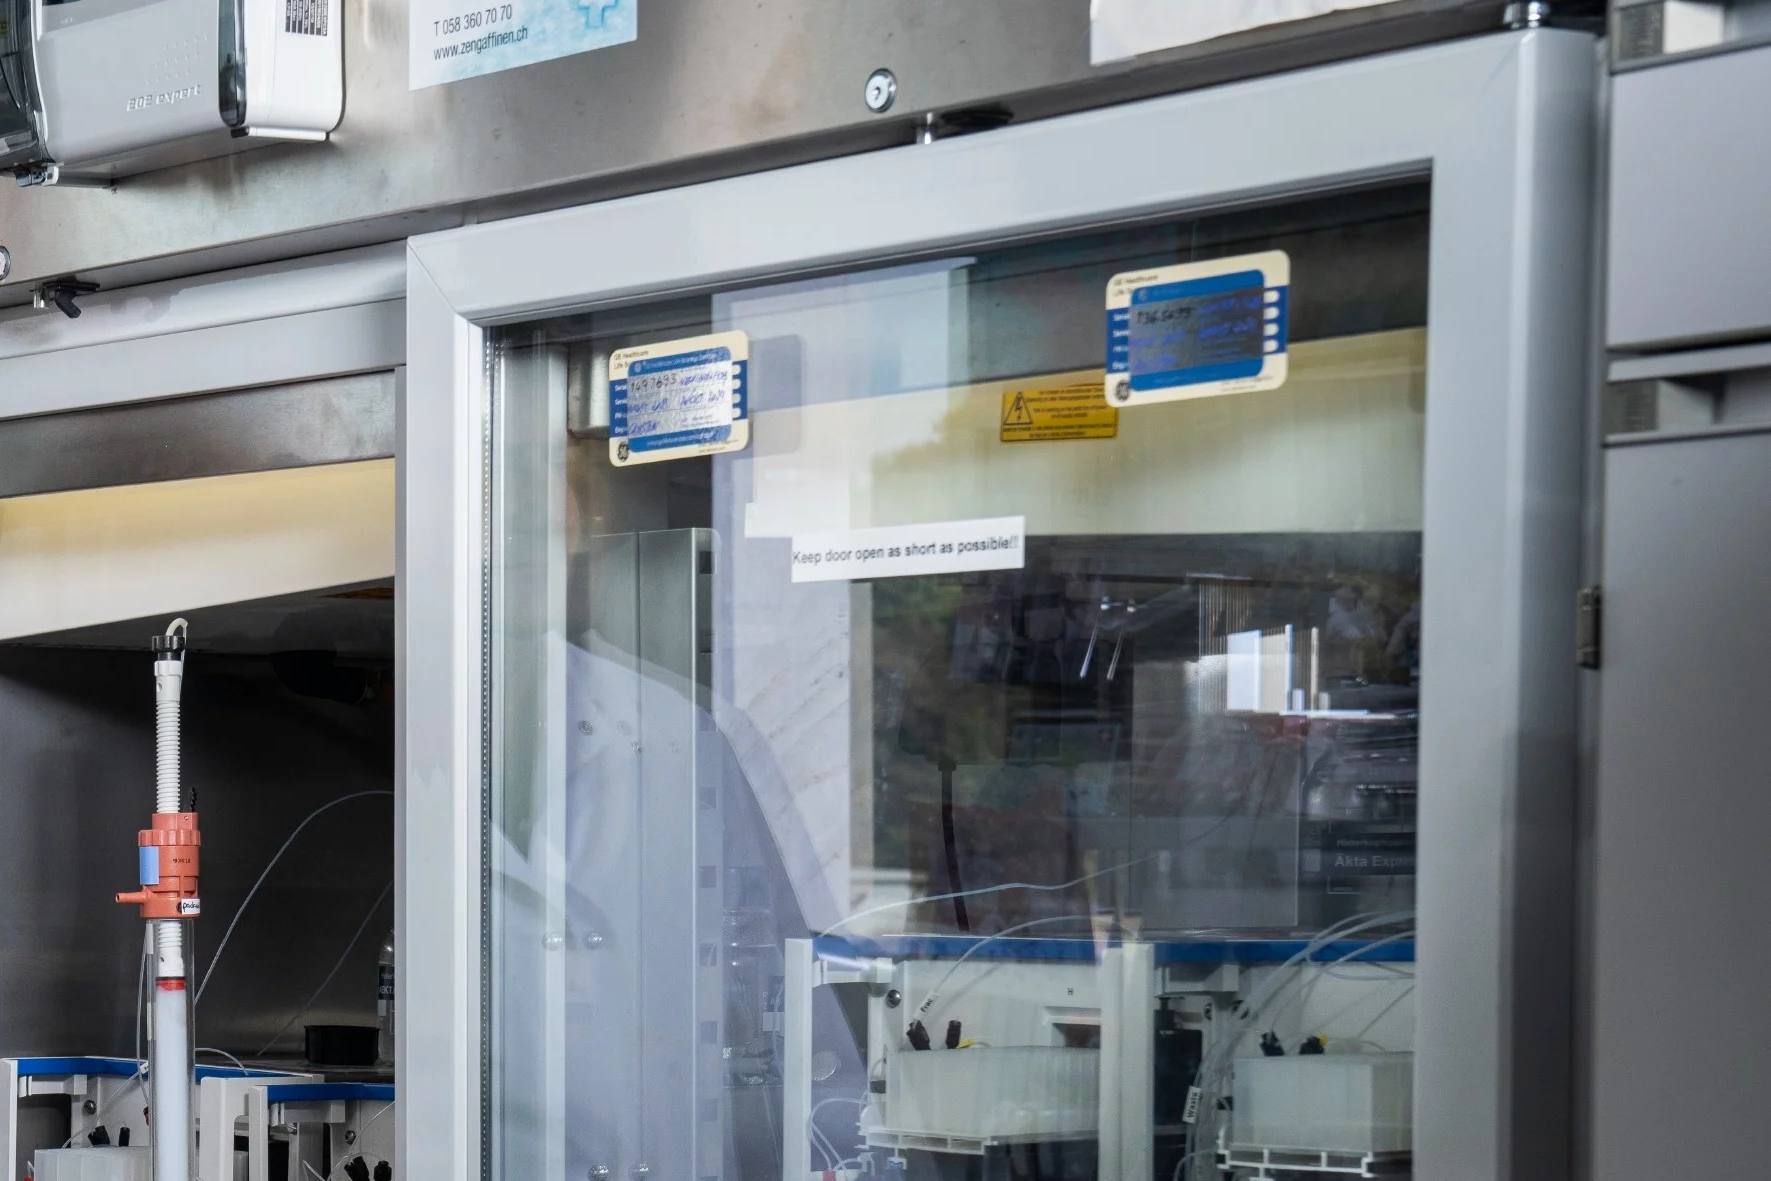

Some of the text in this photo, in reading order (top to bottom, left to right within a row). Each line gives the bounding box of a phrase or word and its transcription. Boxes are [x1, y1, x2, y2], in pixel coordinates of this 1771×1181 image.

[433, 4, 512, 36] T 058 360 70 70
[433, 25, 528, 61] www.zengaffinen.ch
[156, 84, 201, 106] expert
[793, 550, 821, 566] Keep
[825, 548, 851, 562] door
[855, 546, 884, 562] open
[887, 545, 901, 558] as
[904, 541, 936, 557] short
[939, 542, 953, 554] as
